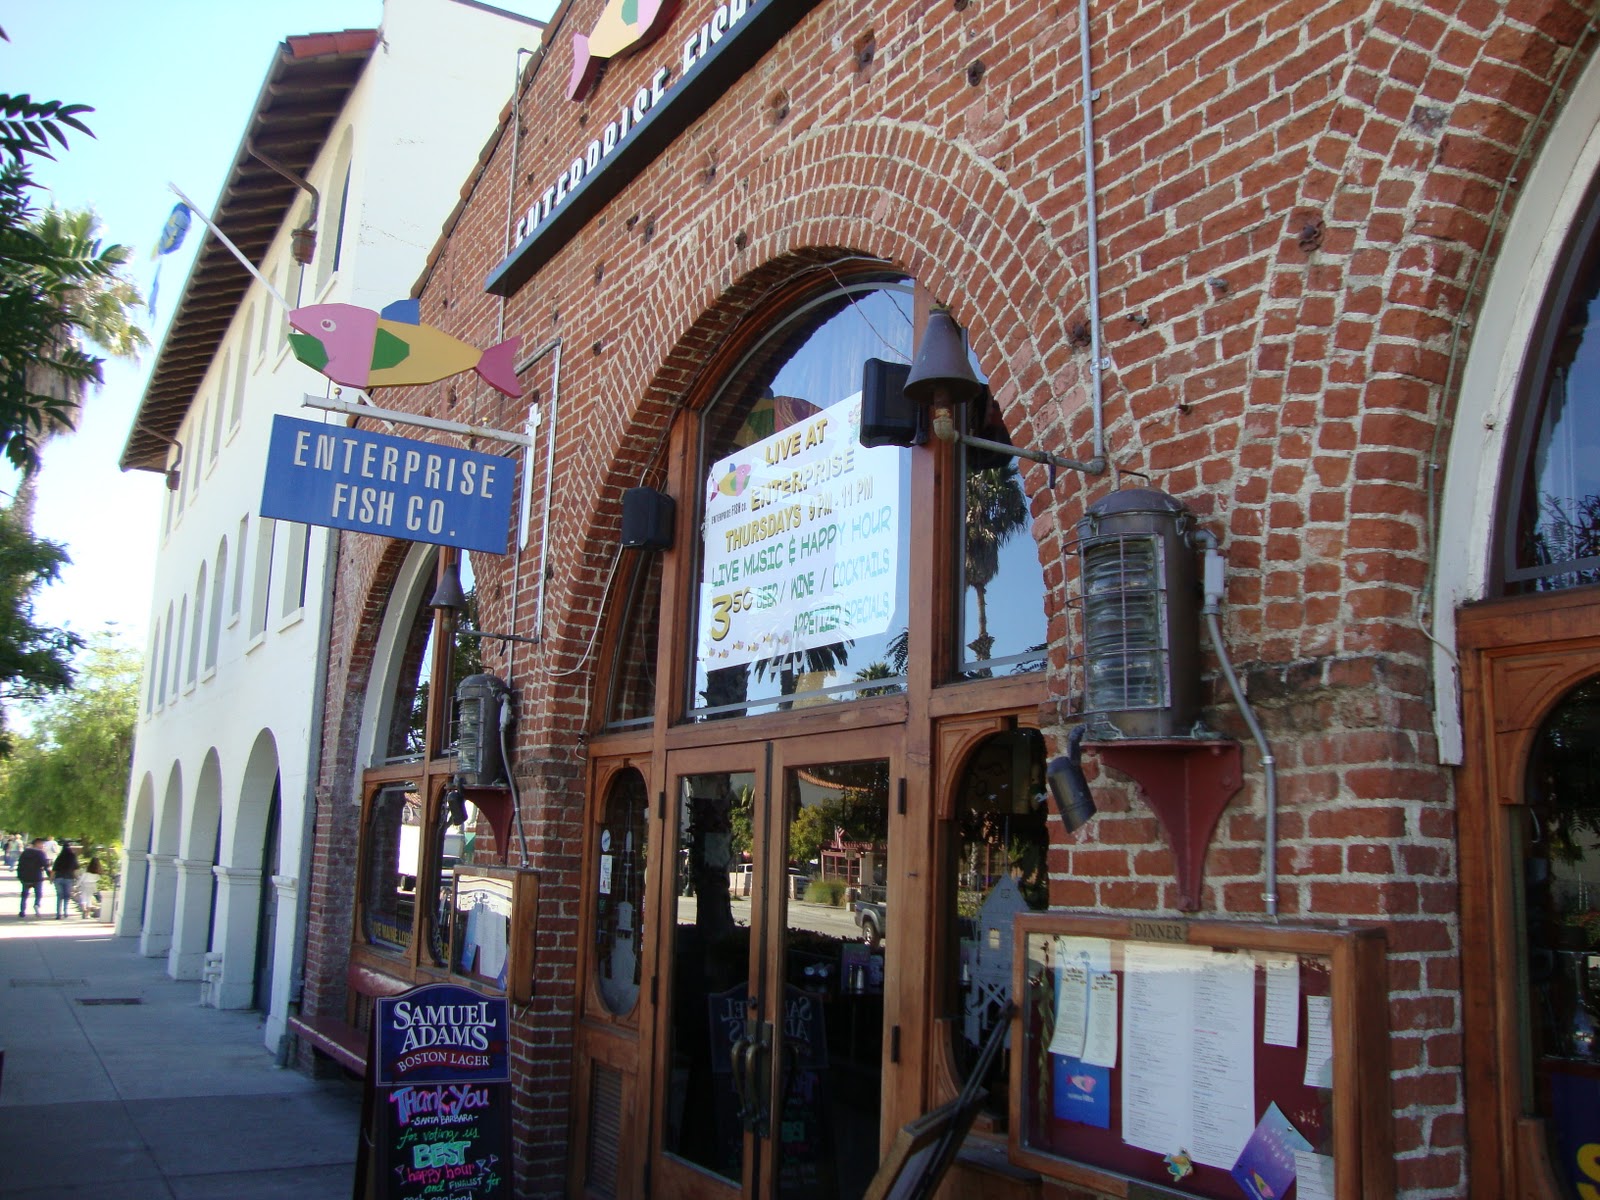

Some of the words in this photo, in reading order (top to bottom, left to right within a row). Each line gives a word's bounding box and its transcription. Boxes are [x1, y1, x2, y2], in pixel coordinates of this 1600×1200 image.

[766, 430, 801, 468] LIVE
[805, 418, 828, 449] AT
[293, 430, 496, 499] ENTERPRISE
[751, 449, 855, 513] ENTERPRISE
[332, 483, 395, 527] FISH
[406, 495, 456, 537] CO.
[725, 503, 802, 553] THURSDAYS
[841, 481, 853, 509] 11
[856, 474, 874, 503] PM
[712, 559, 739, 587] LIVE
[743, 542, 784, 577] MUSIC
[801, 521, 846, 559] HAPPY
[851, 505, 892, 542] HOUR
[790, 570, 815, 600] WINE
[833, 548, 890, 588] COCKTAILS
[844, 591, 890, 627] SPECIALS
[1135, 922, 1183, 940] DINNER
[393, 1001, 496, 1030] SAMUEL
[399, 1025, 489, 1055] ADAMS
[397, 1051, 447, 1072] BOSTON
[451, 1053, 490, 1066] LAGER
[397, 1127, 418, 1149] for
[423, 1127, 459, 1143] voting
[462, 1127, 480, 1139] us
[413, 1140, 472, 1169] BEST
[407, 1166, 441, 1185] happy
[446, 1163, 475, 1179] hour
[424, 1179, 445, 1194] and
[449, 1176, 483, 1190] FINALIST
[485, 1172, 502, 1193] for
